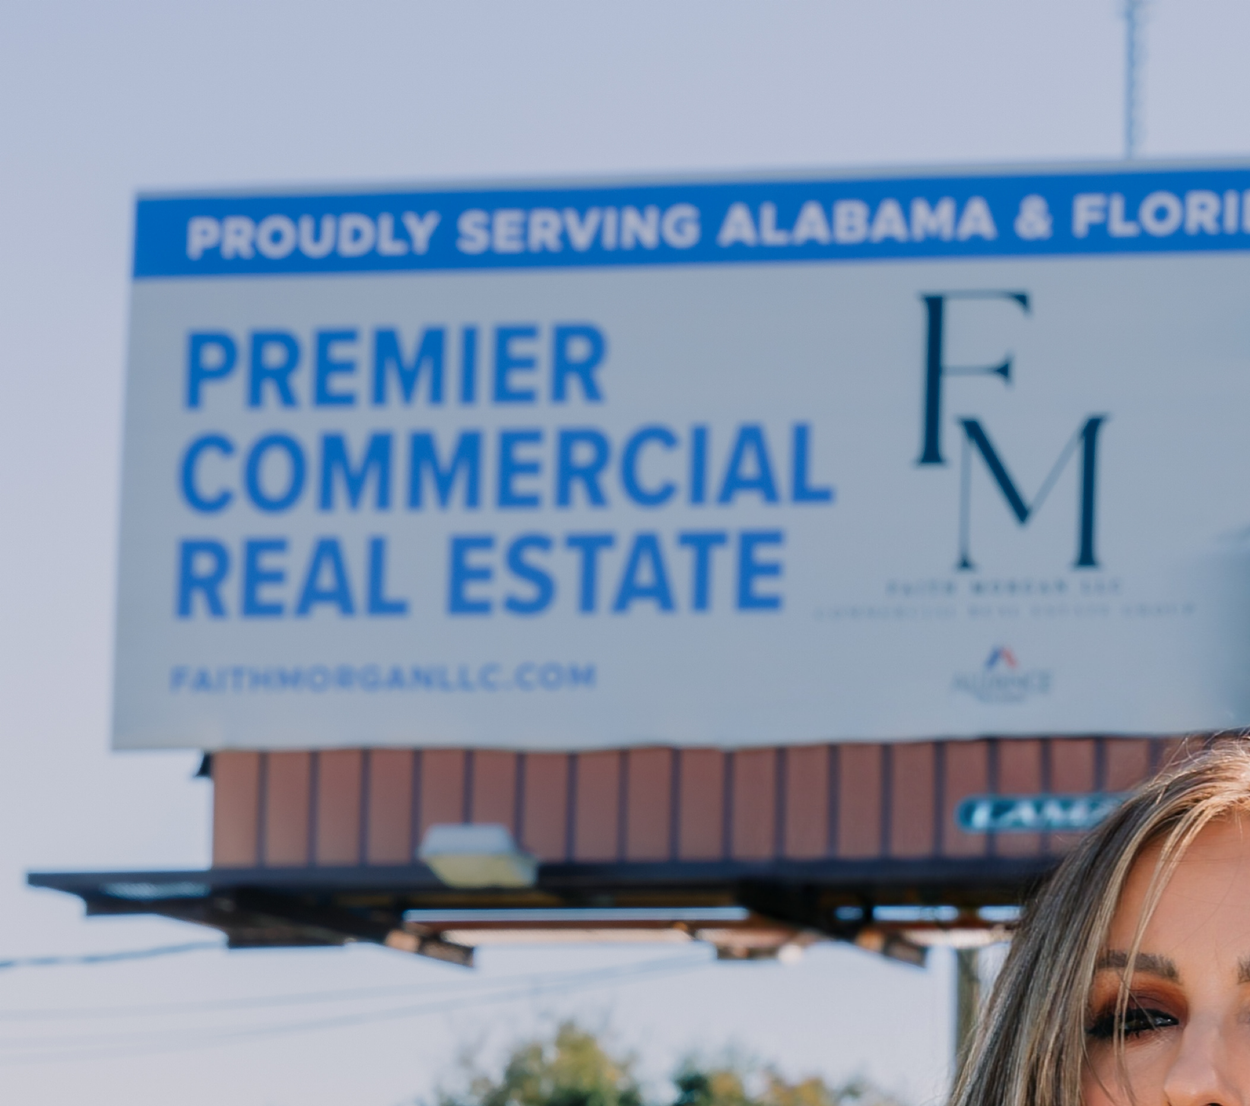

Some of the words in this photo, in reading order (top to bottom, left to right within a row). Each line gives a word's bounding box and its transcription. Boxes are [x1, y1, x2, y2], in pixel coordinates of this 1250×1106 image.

[186, 211, 441, 261] PROUDLY
[457, 205, 701, 255] SERVING
[717, 196, 998, 247] ALABAMA
[1014, 194, 1053, 240] &
[184, 323, 608, 410] PREMIER
[915, 288, 1032, 466] F
[178, 421, 836, 515] COMMERCIAL
[952, 412, 1110, 572] M
[174, 536, 410, 619] REAL
[445, 528, 786, 617] ESTATE
[170, 661, 597, 695] FAITHMORGANLLC.COM
